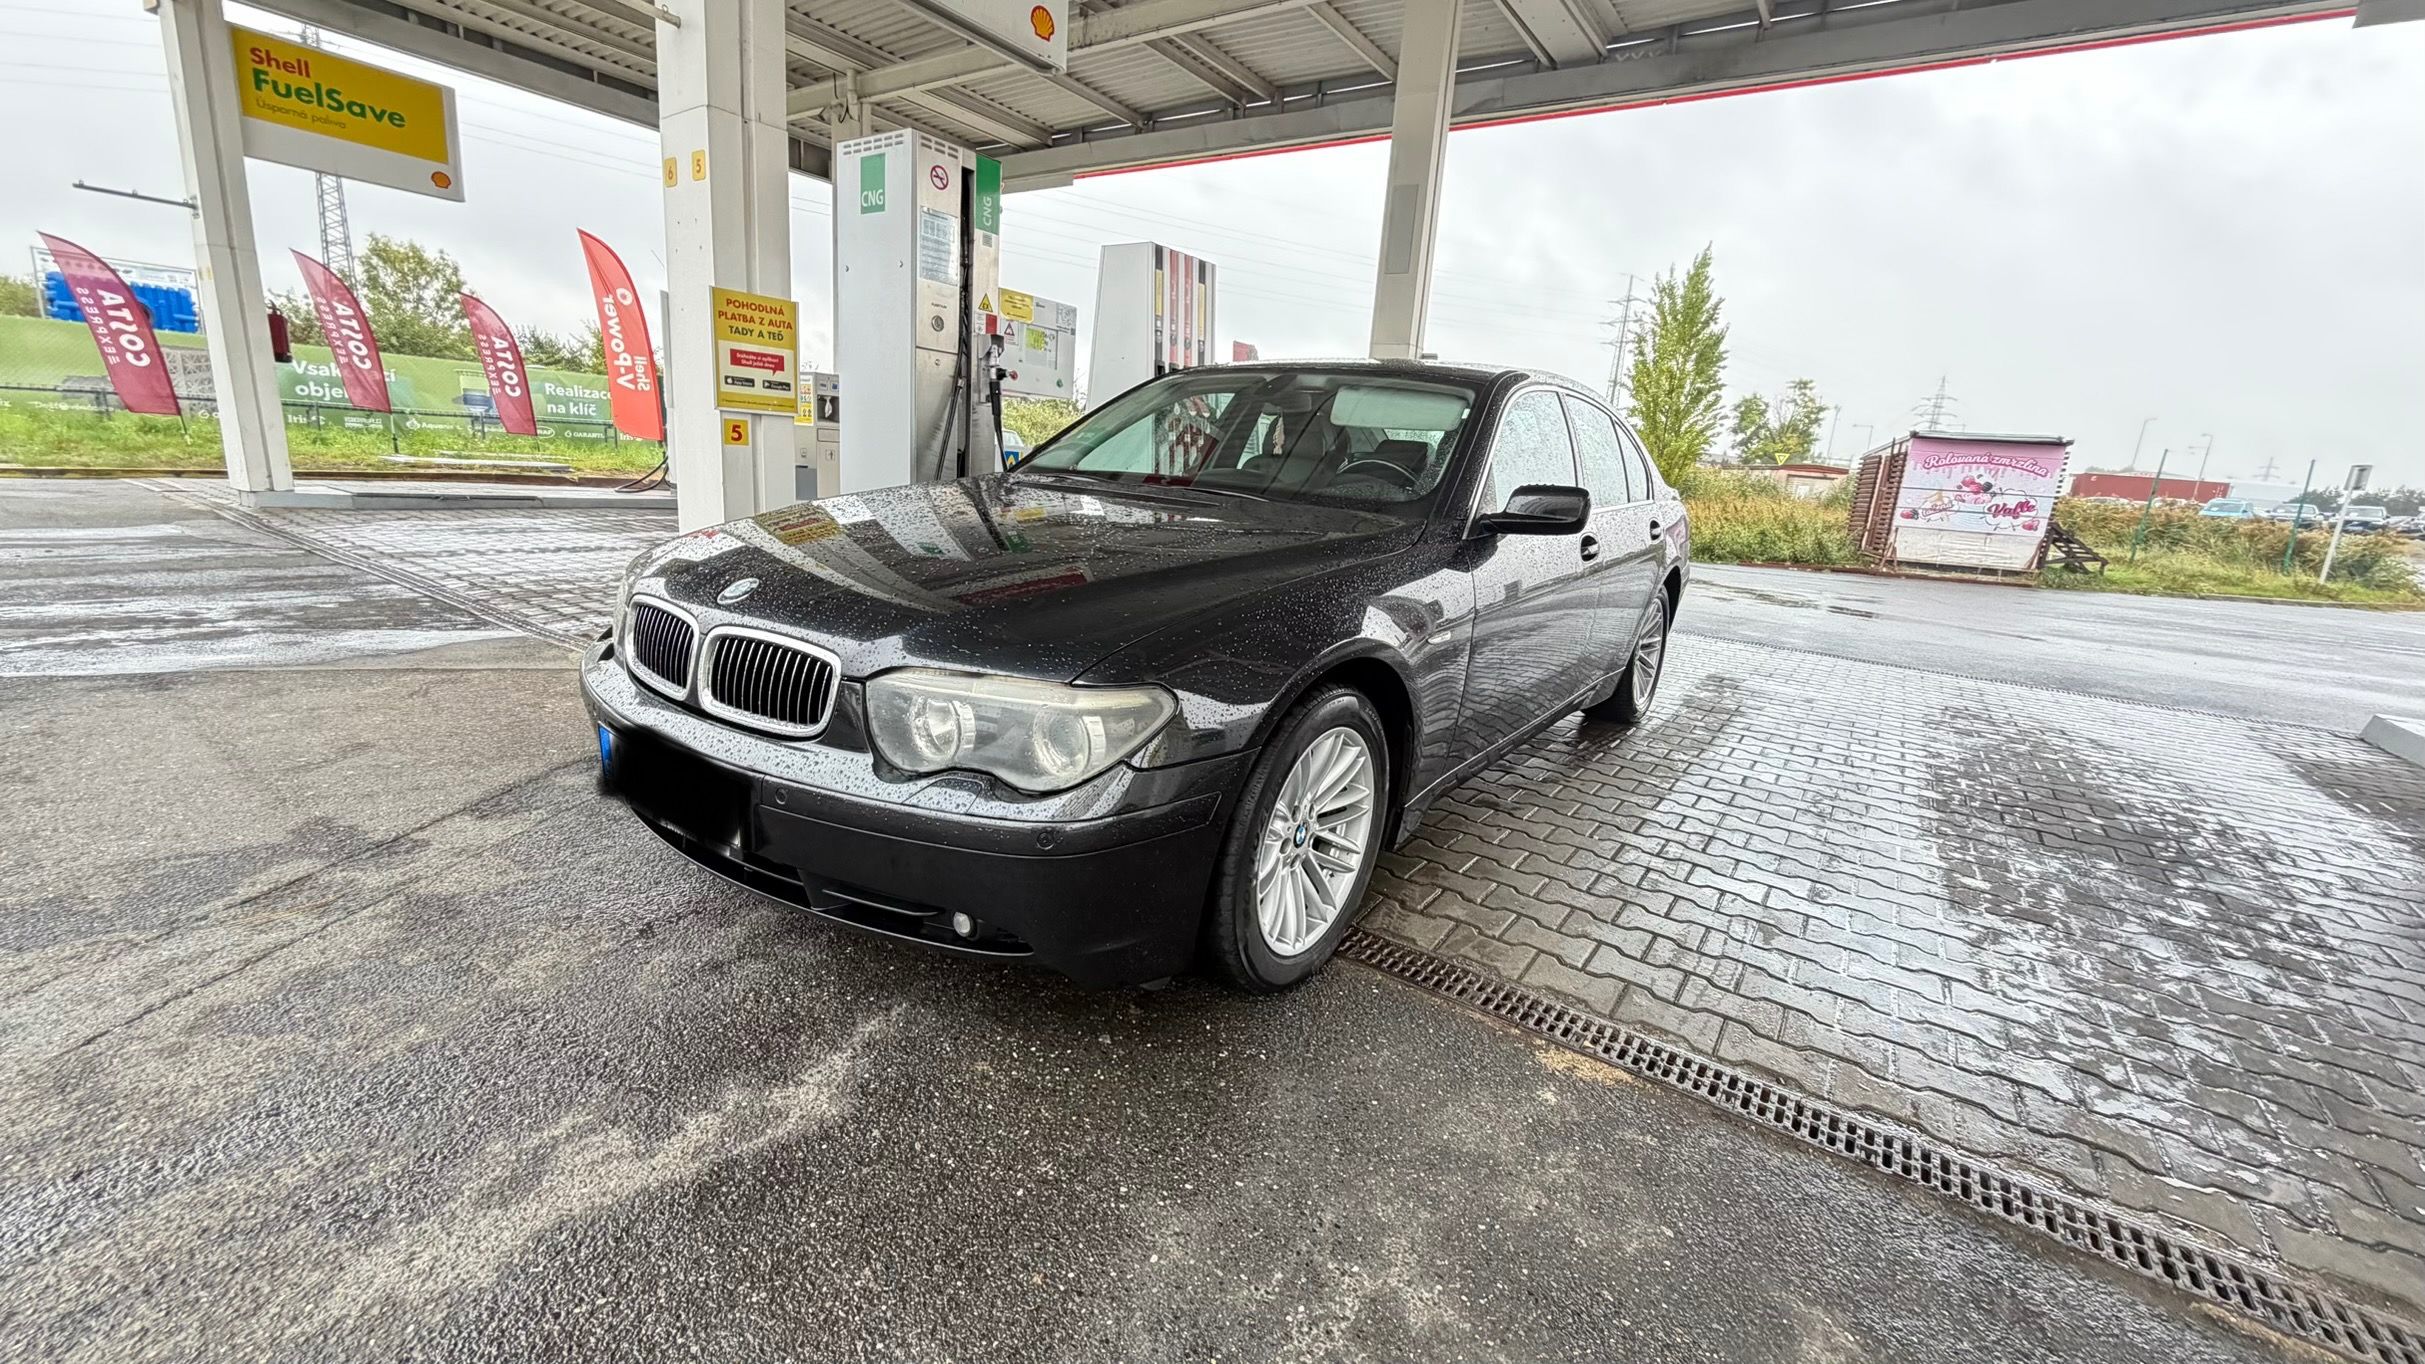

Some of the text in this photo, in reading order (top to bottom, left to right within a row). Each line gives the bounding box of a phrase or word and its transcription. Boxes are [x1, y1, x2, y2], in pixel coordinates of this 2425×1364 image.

[249, 47, 311, 78] Shell
[252, 67, 406, 128] FuelSave
[667, 167, 674, 181] 6
[695, 158, 702, 174] 5
[861, 188, 884, 208] CNG
[984, 196, 992, 226] CNG
[726, 297, 785, 316] POHODLNÁ
[718, 309, 793, 330] PLATBA Z AUTA
[728, 325, 754, 337] TADY
[768, 329, 784, 341] TEĎ
[547, 403, 597, 416] na klíč
[730, 424, 743, 442] 5
[1925, 453, 2047, 477] Rolovaná zmrzlina
